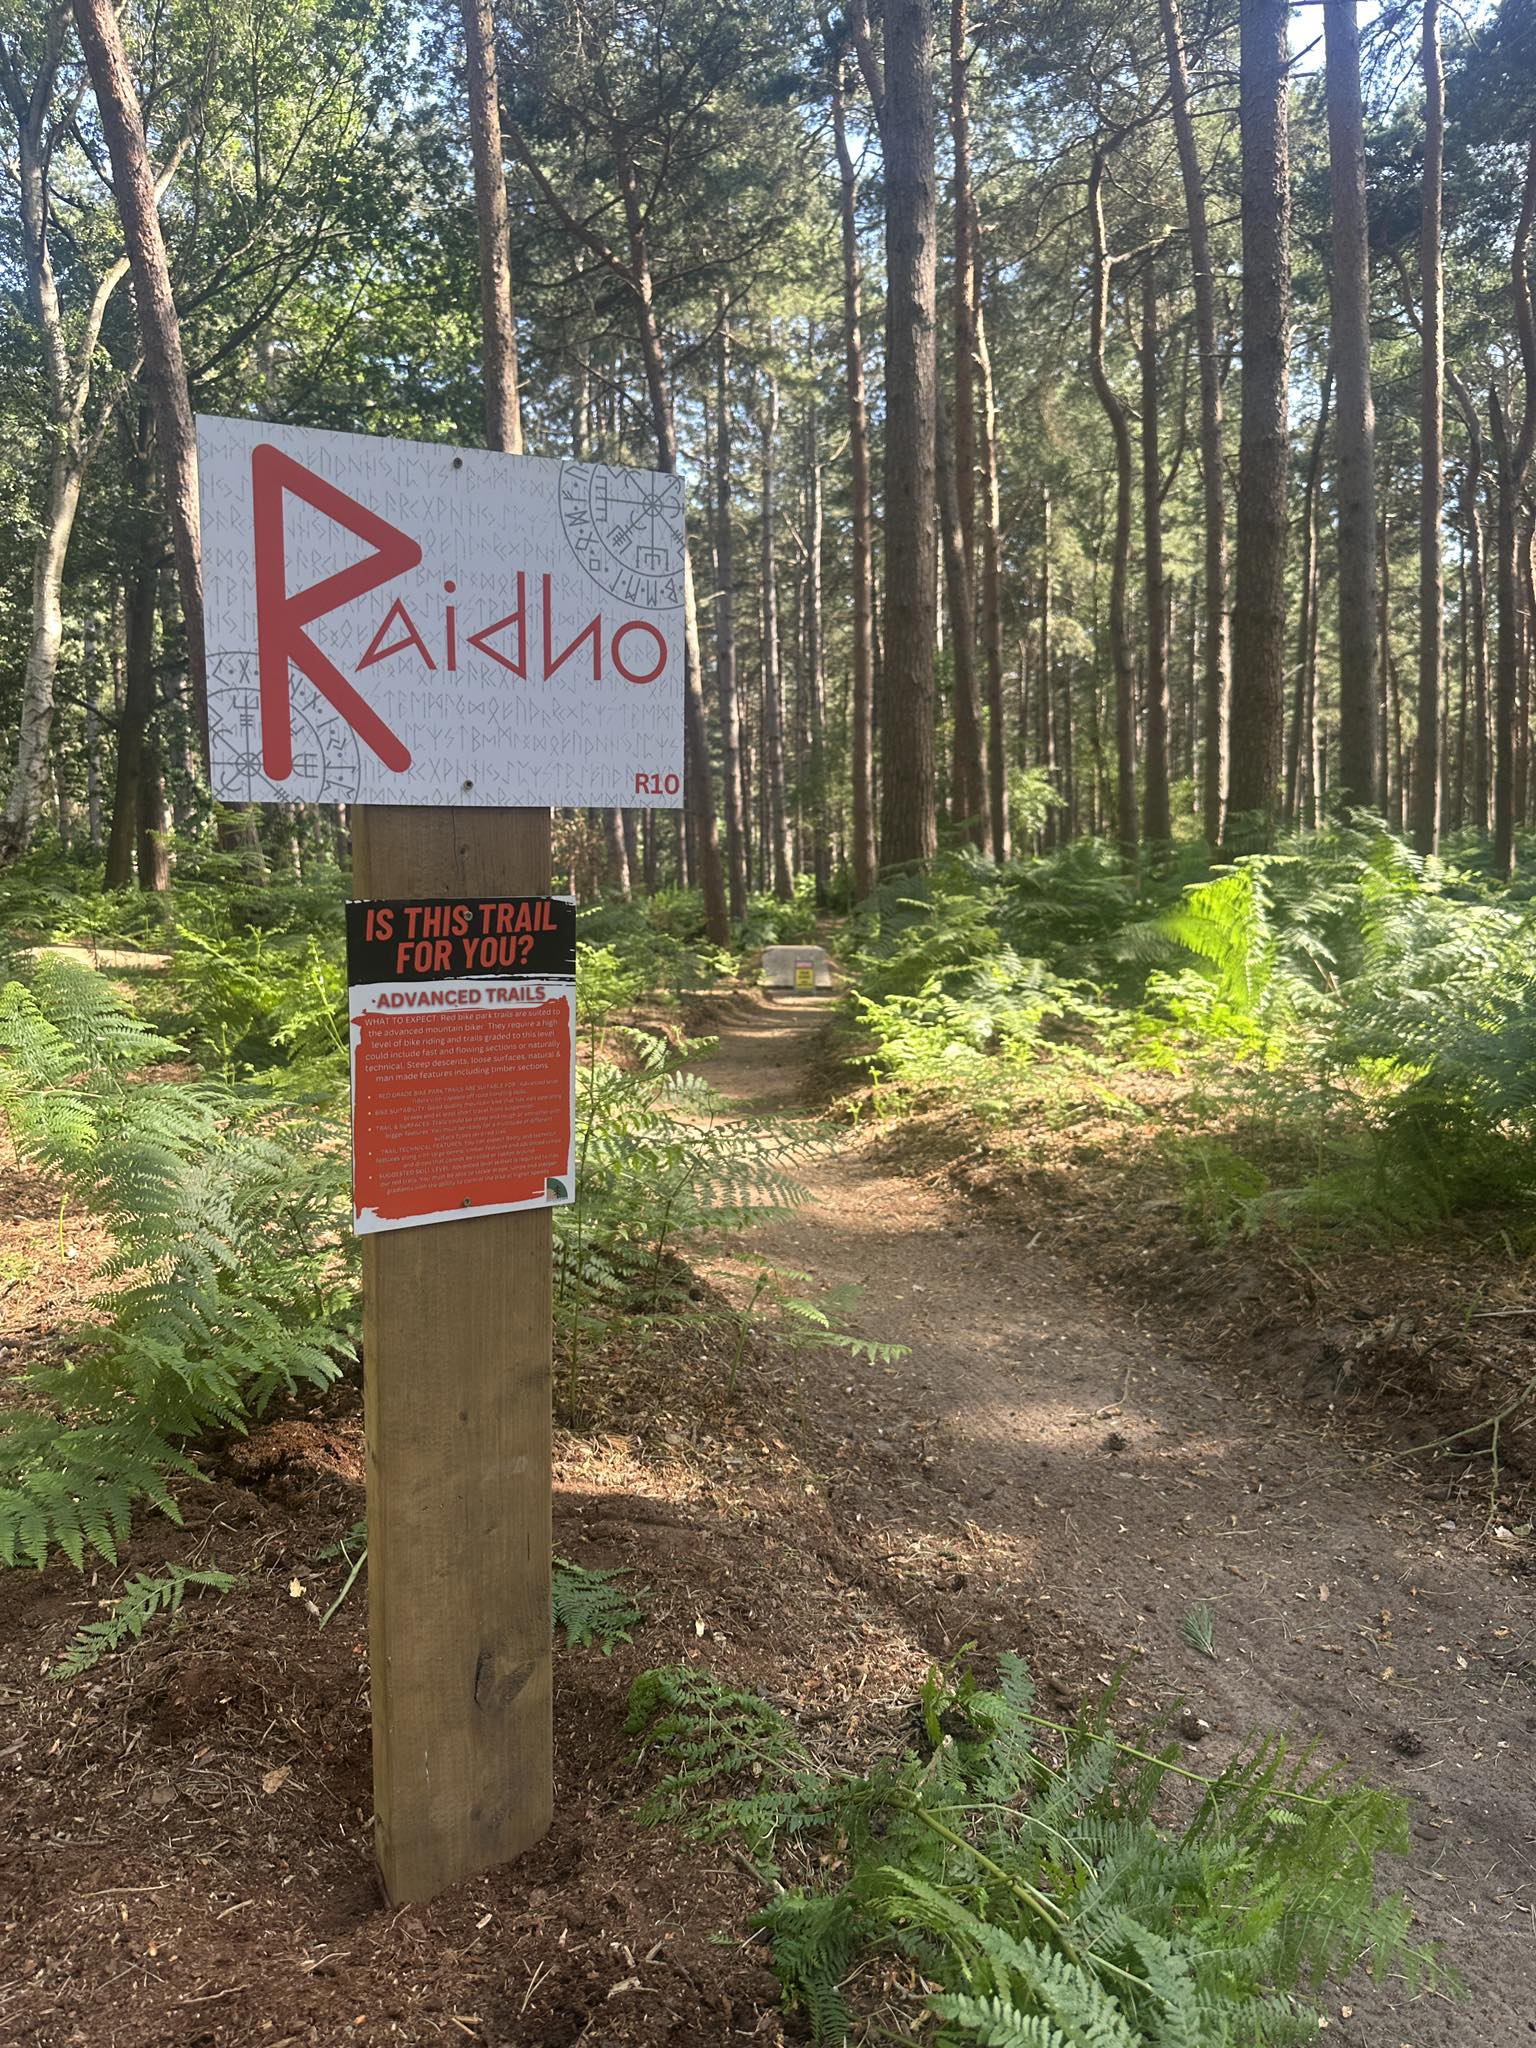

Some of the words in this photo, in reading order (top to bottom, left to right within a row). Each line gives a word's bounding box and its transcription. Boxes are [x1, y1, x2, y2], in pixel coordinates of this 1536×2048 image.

[634, 773, 679, 795] R10
[365, 908, 394, 942] IS
[404, 905, 471, 939] THIS
[479, 901, 558, 935] TRAIL
[397, 940, 453, 974] FOR
[462, 935, 535, 969] YOU?
[376, 989, 482, 1009] ADVANCED
[486, 985, 546, 1003] TRAILS
[365, 1017, 390, 1026] WHAT
[392, 1016, 404, 1025] TO
[368, 1030, 383, 1038] the
[383, 1027, 424, 1037] advanced
[425, 1025, 464, 1034] mountain
[488, 1021, 506, 1031] They
[371, 1040, 392, 1049] level
[393, 1039, 402, 1047] of
[404, 1038, 421, 1047] bike
[422, 1036, 446, 1046] riding
[446, 1035, 462, 1044] and
[463, 1034, 483, 1042] trails
[484, 1032, 511, 1042] graded
[522, 1030, 537, 1038] this
[365, 1051, 389, 1061] could
[390, 1049, 421, 1058] include
[422, 1048, 438, 1057] fast
[439, 1047, 454, 1056] and
[455, 1045, 484, 1054] flowing
[485, 1043, 517, 1052] sections
[518, 1042, 526, 1050] or
[375, 1075, 394, 1083] man
[395, 1072, 418, 1081] made
[419, 1070, 453, 1079] features
[453, 1066, 490, 1076] including
[491, 1064, 516, 1073] timber
